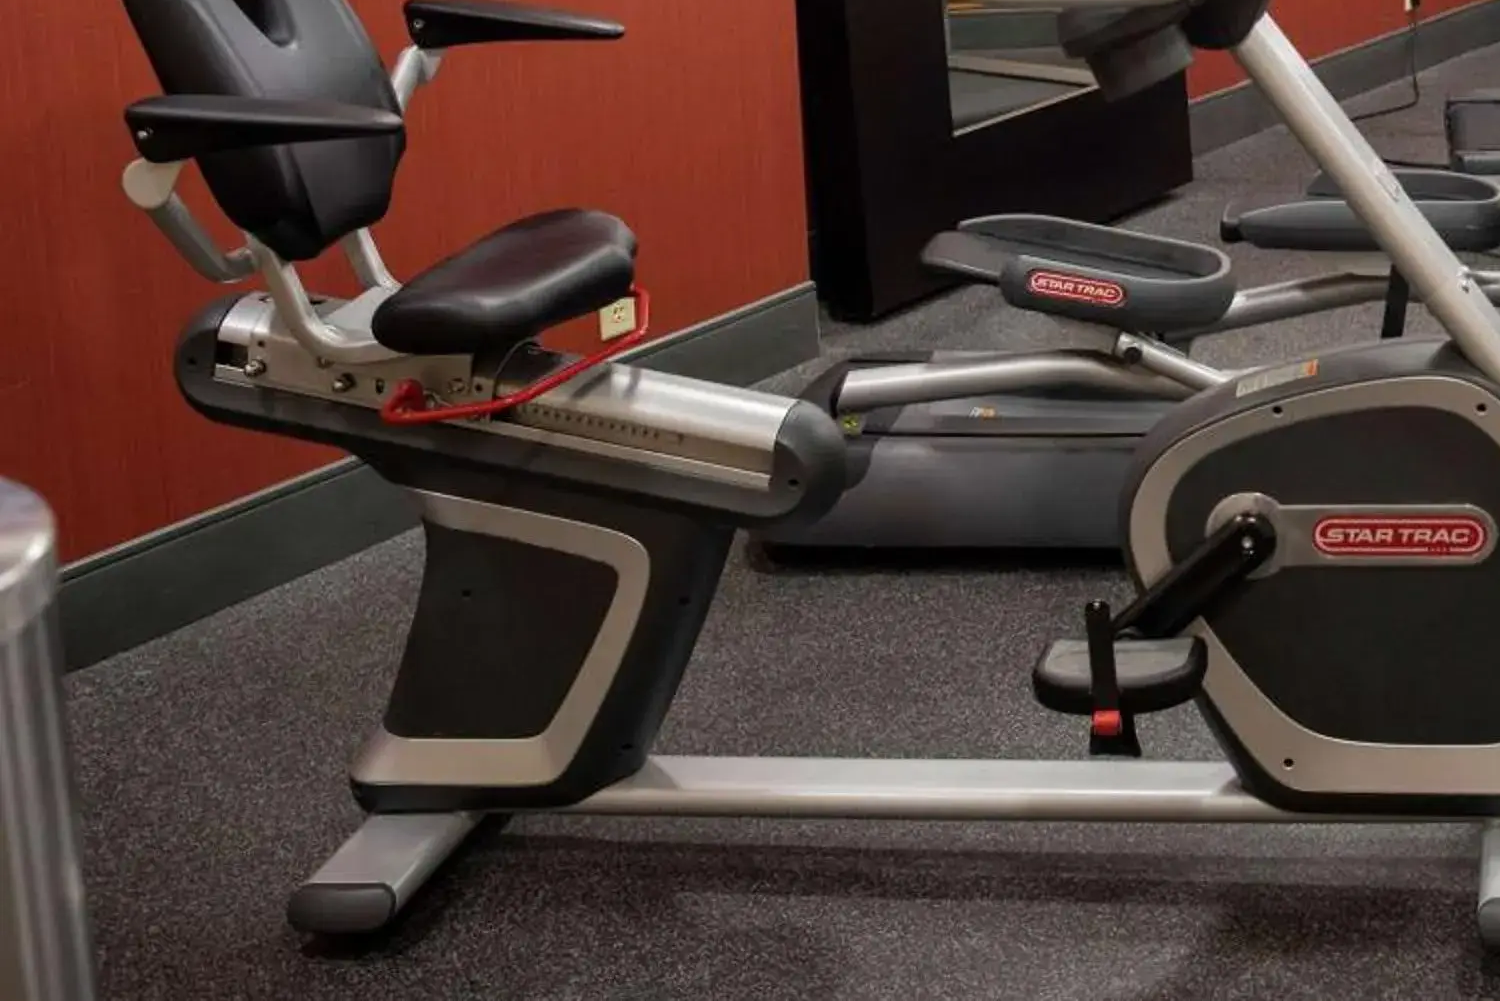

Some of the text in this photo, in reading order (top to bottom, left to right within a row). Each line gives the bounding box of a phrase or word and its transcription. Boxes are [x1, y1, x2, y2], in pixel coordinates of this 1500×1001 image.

[1035, 277, 1116, 297] STAR TRAC
[1325, 528, 1471, 543] STAR TRAC
